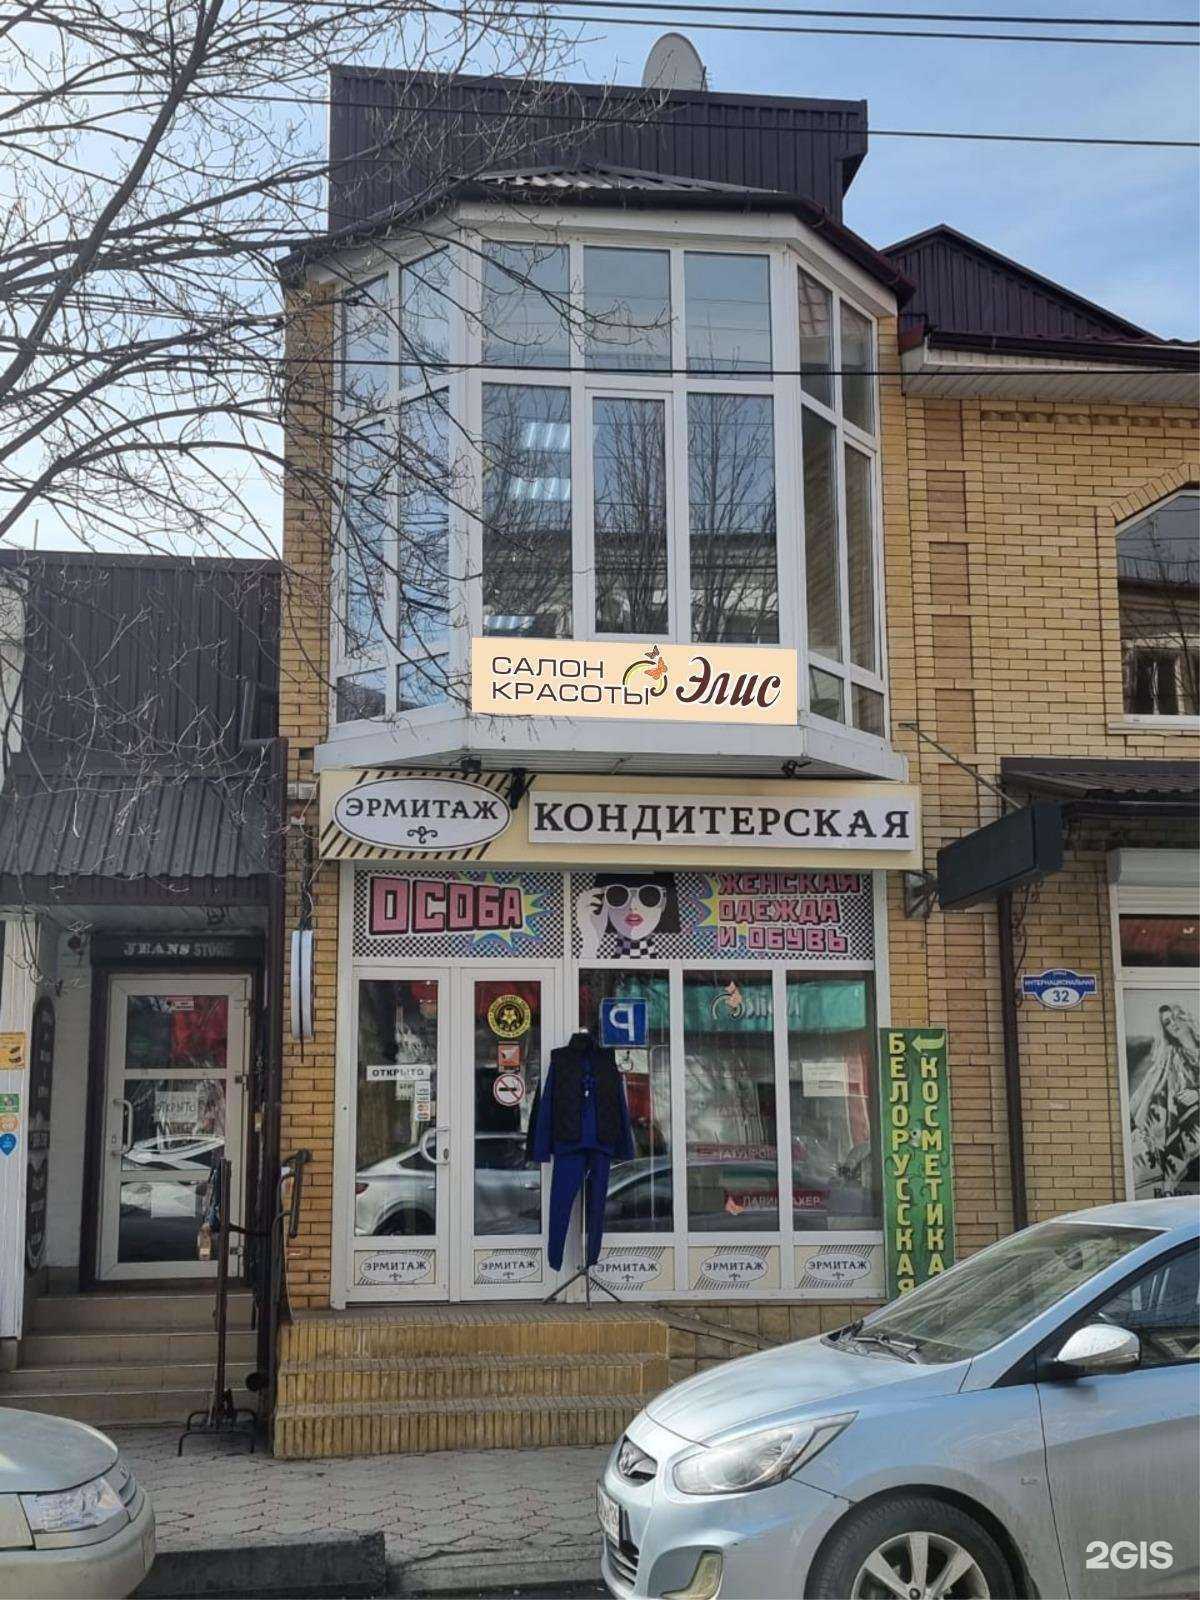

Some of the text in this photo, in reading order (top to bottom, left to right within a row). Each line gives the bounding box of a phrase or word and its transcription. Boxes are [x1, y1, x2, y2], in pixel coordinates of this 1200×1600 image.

[492, 656, 781, 709] САЛОН Элис
[492, 680, 649, 706] КРАСОТЫ
[346, 797, 499, 821] ЭРМИТАЖ
[535, 801, 910, 839] КОНДИТЕРСКАЯ
[718, 873, 860, 896] ЖЕНСКАЯ
[369, 875, 523, 936] ОСОБА
[719, 899, 841, 925] ОДЕЖДА
[719, 926, 848, 953] И ОБУВЬ
[1052, 989, 1070, 1002] 32
[888, 1033, 915, 1296] БЕЛОРУССКАЯ
[920, 1056, 945, 1277] КОСМЕТИКА
[364, 1260, 427, 1271] ЭРМИТАЖ
[481, 1261, 536, 1270] ЭРМИТАЖ
[597, 1262, 658, 1273] ЭРМИТАЖ
[705, 1262, 764, 1272] ЭРМИТАЖ
[808, 1260, 868, 1270] ЭРМИТАЖ
